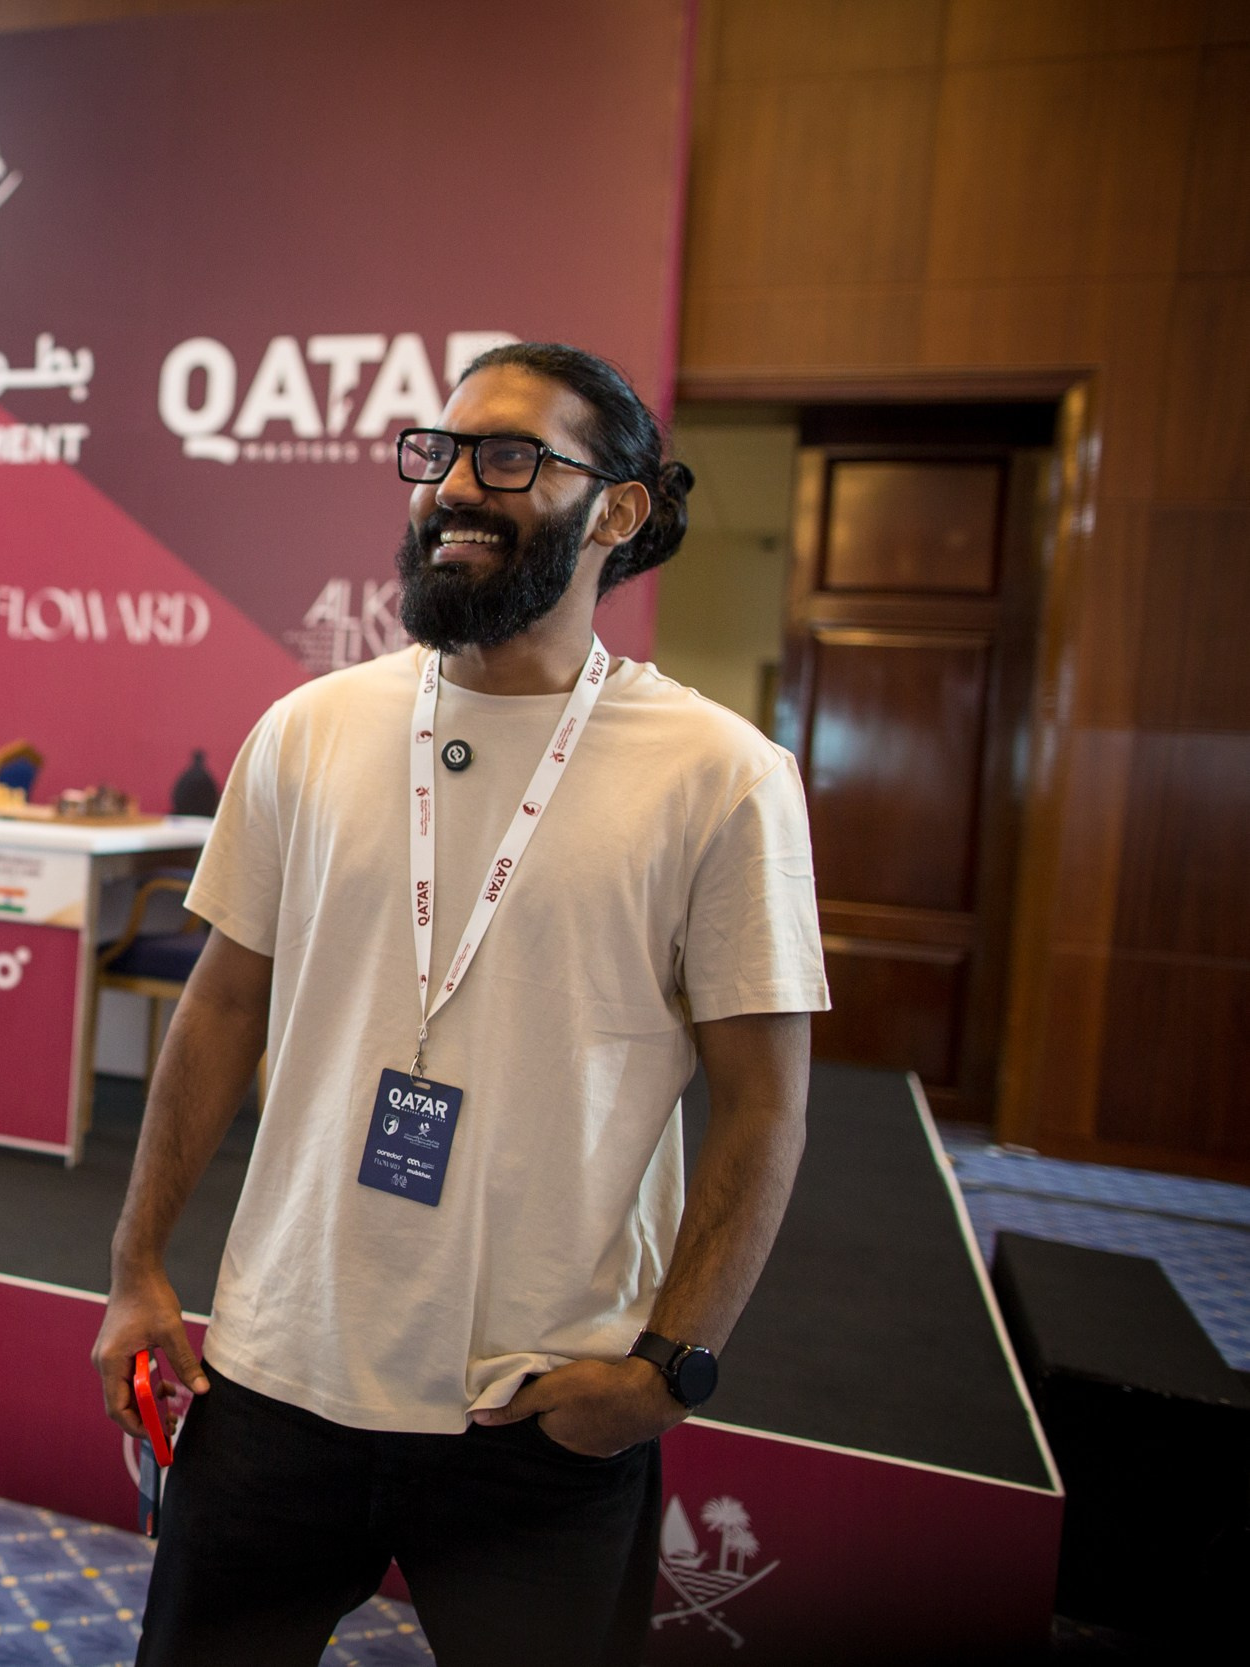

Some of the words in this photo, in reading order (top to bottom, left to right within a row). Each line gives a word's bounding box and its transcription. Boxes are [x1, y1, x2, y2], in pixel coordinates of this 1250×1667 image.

[586, 651, 607, 685] QATAR
[485, 858, 513, 903] QATAR
[417, 881, 431, 927] QATAR
[388, 1088, 448, 1119] QATAR
[376, 1149, 403, 1161] ooredoo
